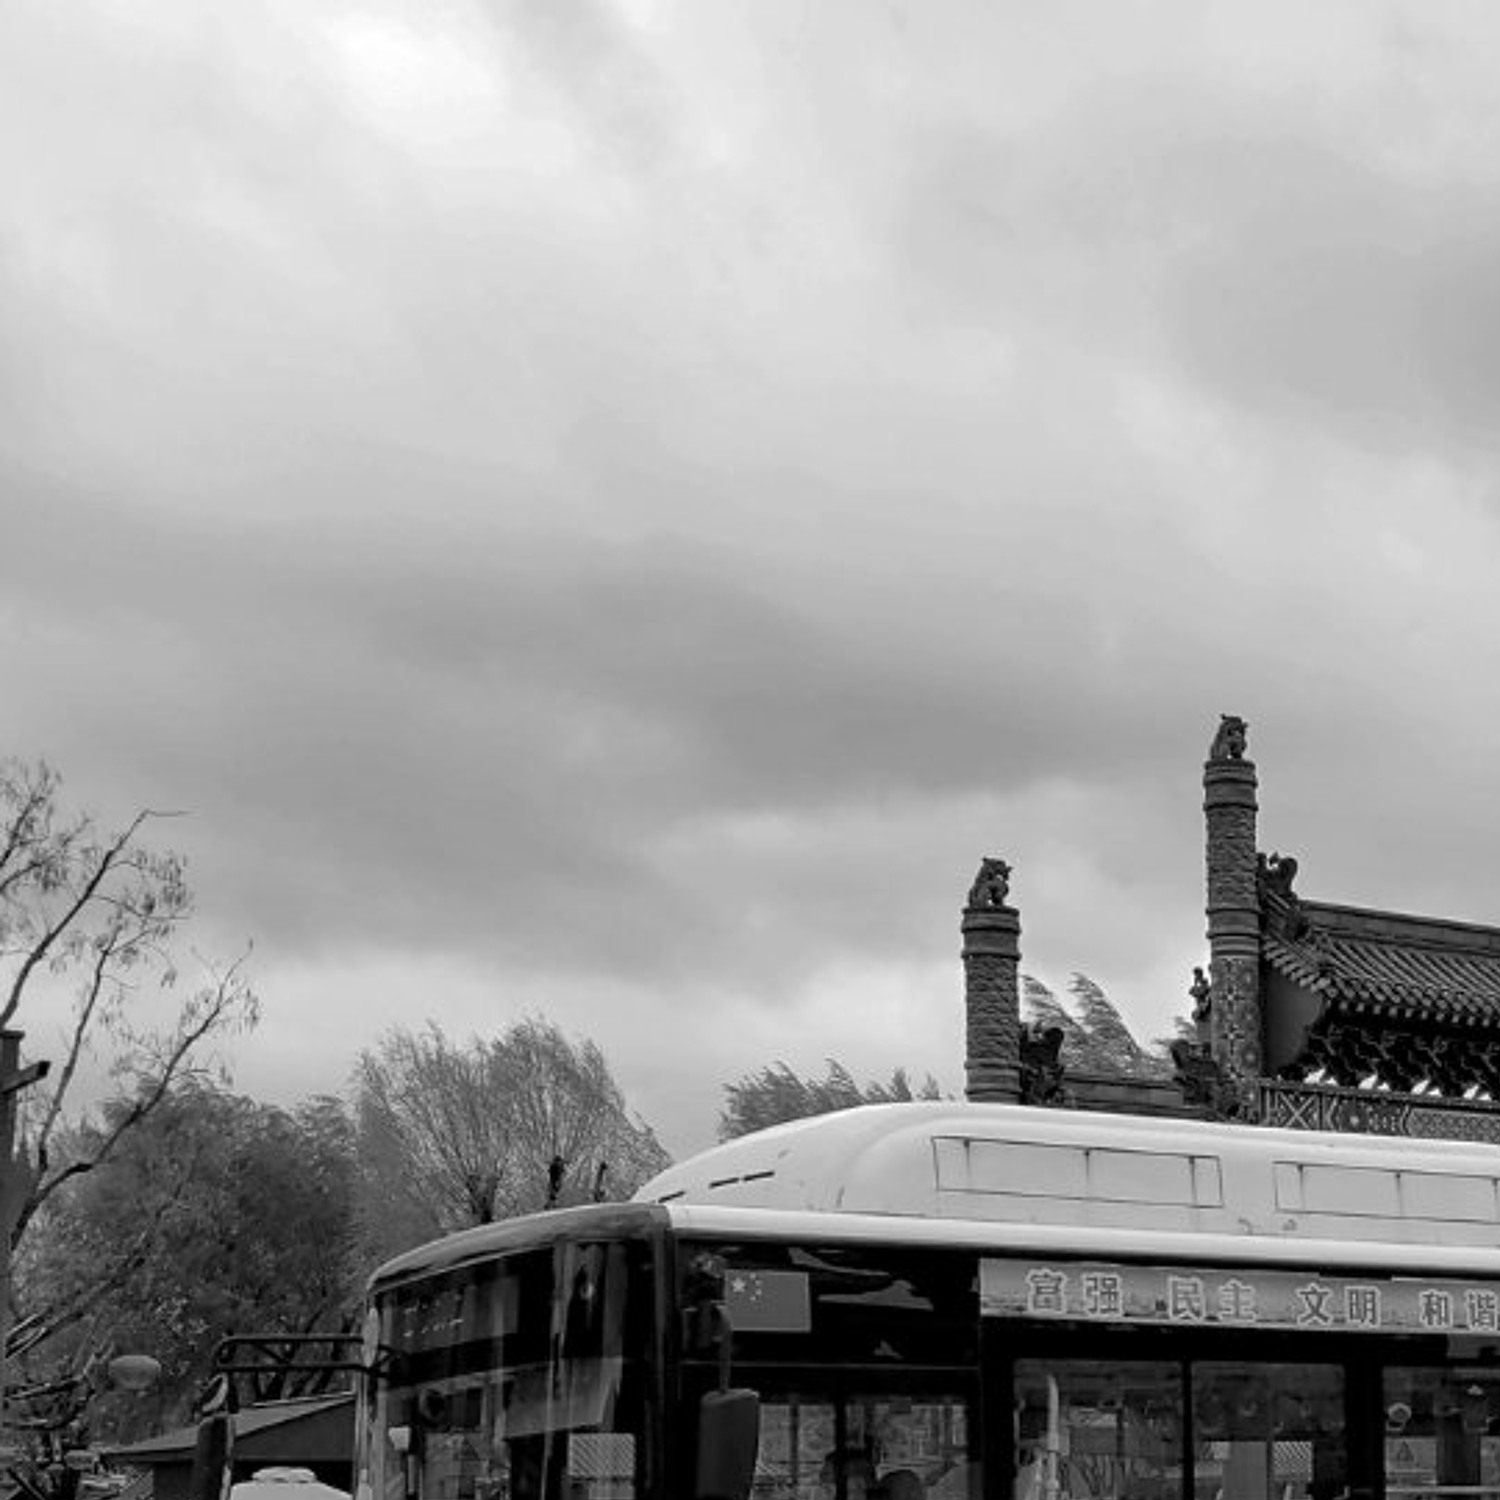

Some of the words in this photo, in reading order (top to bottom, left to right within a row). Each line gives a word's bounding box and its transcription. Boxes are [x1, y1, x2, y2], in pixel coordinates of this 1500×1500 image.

[1025, 1268, 1122, 1317] 富强
[1167, 1276, 1258, 1323] 民主
[1297, 1283, 1380, 1326] 文明
[1420, 1289, 1497, 1331] 和谐
